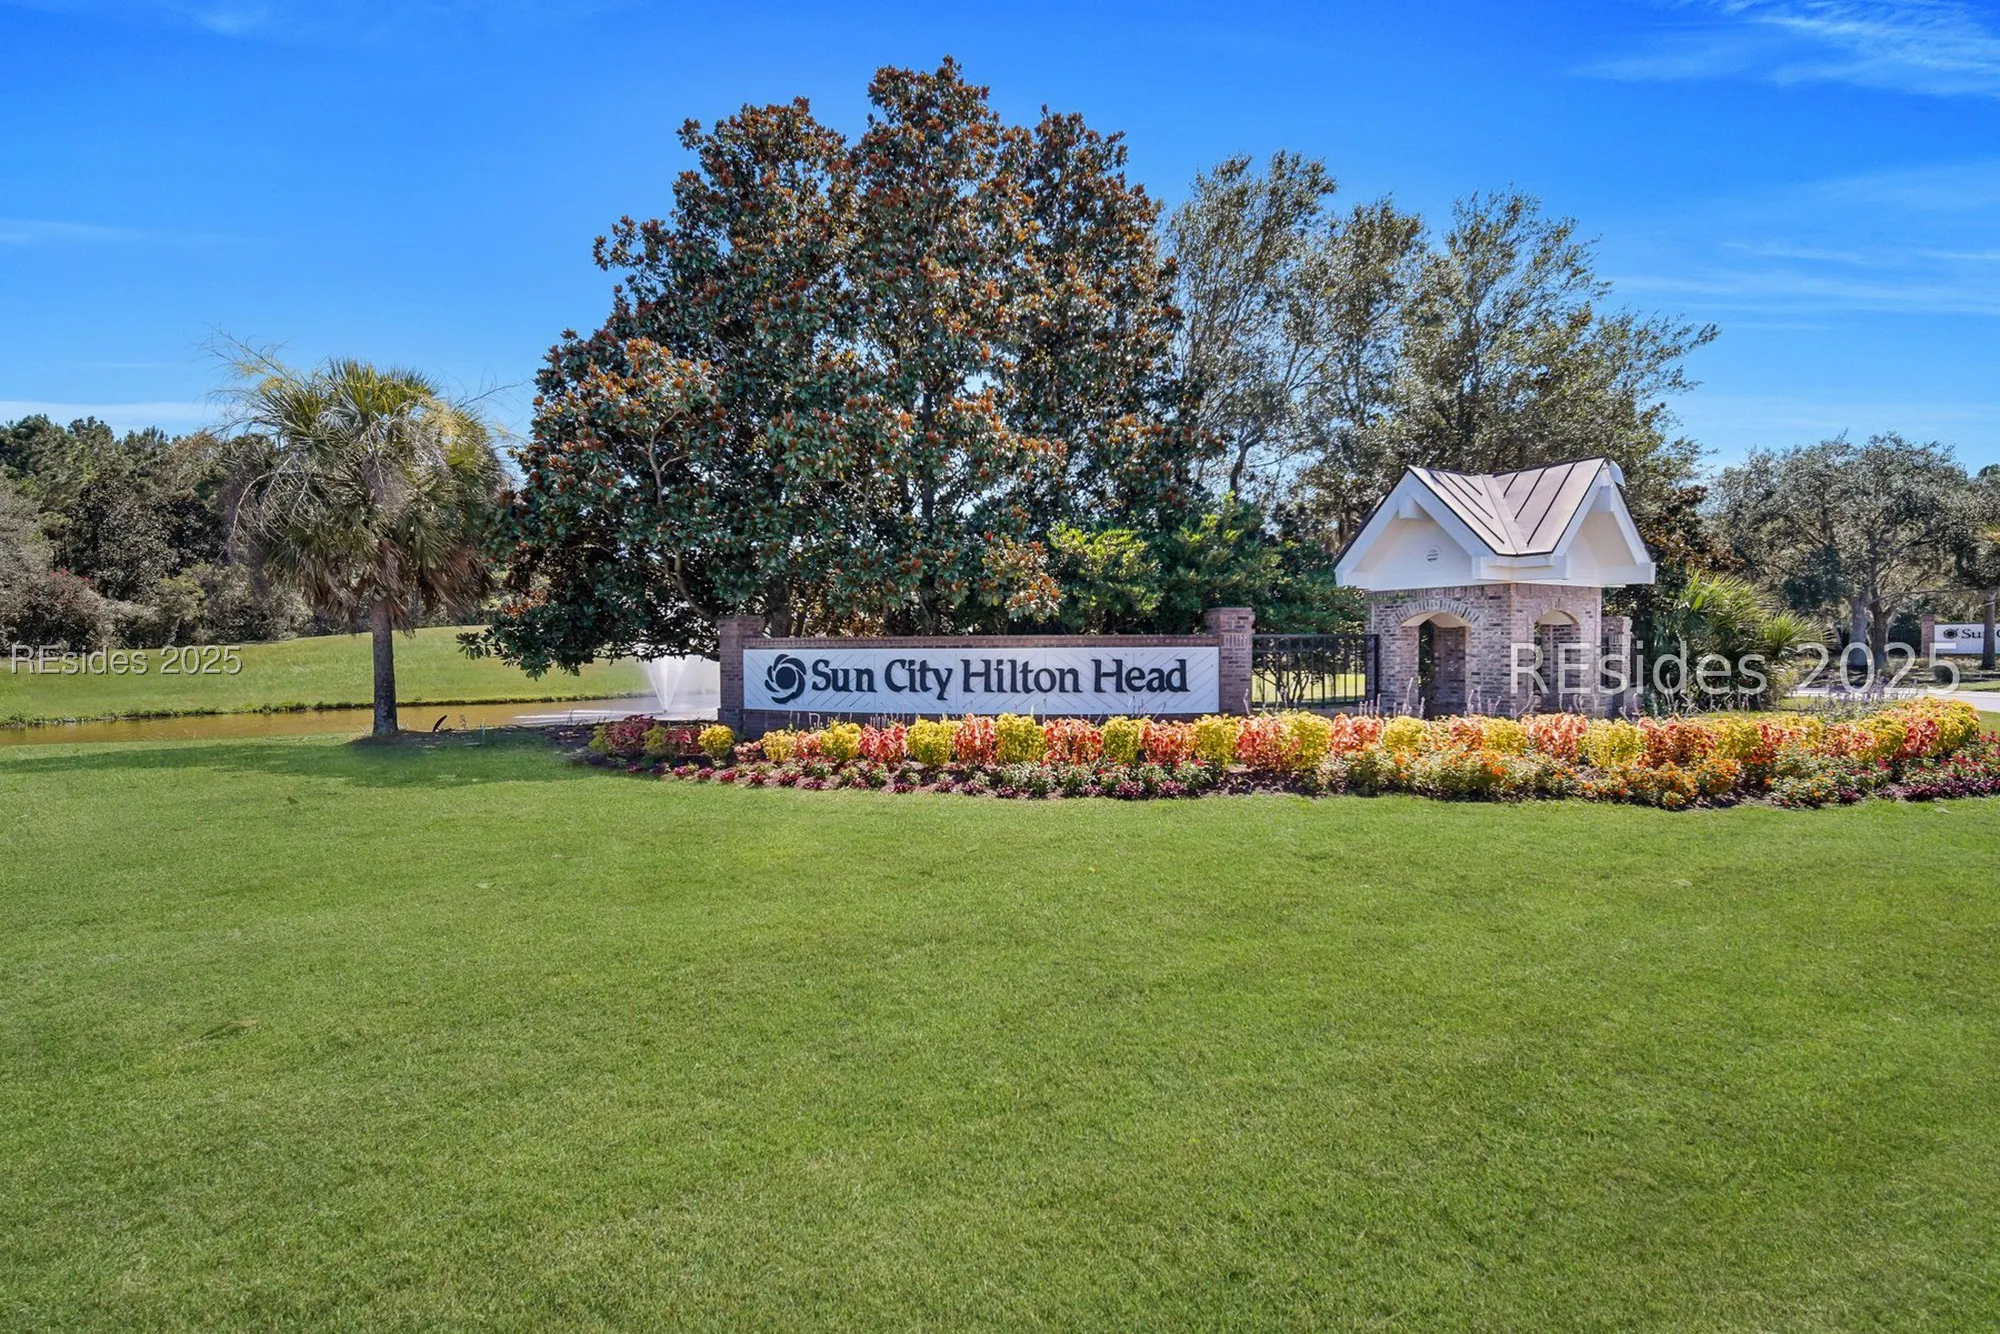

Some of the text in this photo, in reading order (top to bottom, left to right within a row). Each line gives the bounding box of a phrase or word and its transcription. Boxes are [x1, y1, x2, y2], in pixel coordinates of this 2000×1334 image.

[1961, 629, 1984, 639] Su
[811, 658, 1190, 700] Sun City Hilton Head
